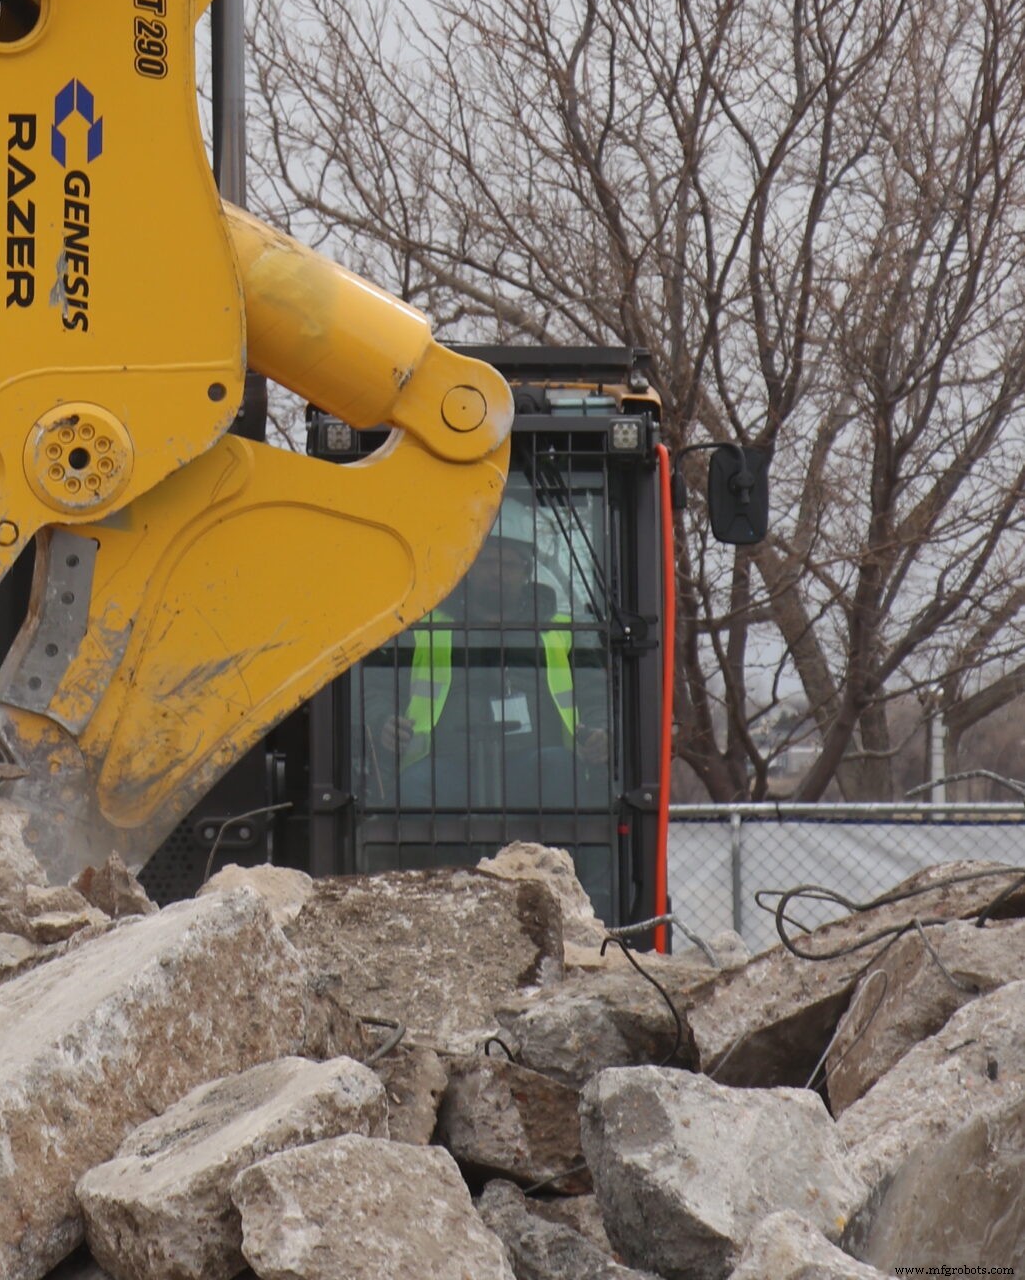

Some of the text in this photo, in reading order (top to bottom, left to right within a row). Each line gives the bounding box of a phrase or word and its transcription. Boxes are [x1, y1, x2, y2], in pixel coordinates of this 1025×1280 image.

[134, 16, 168, 80] 290
[6, 113, 37, 309] RAZER
[62, 170, 91, 333] GENESIS
